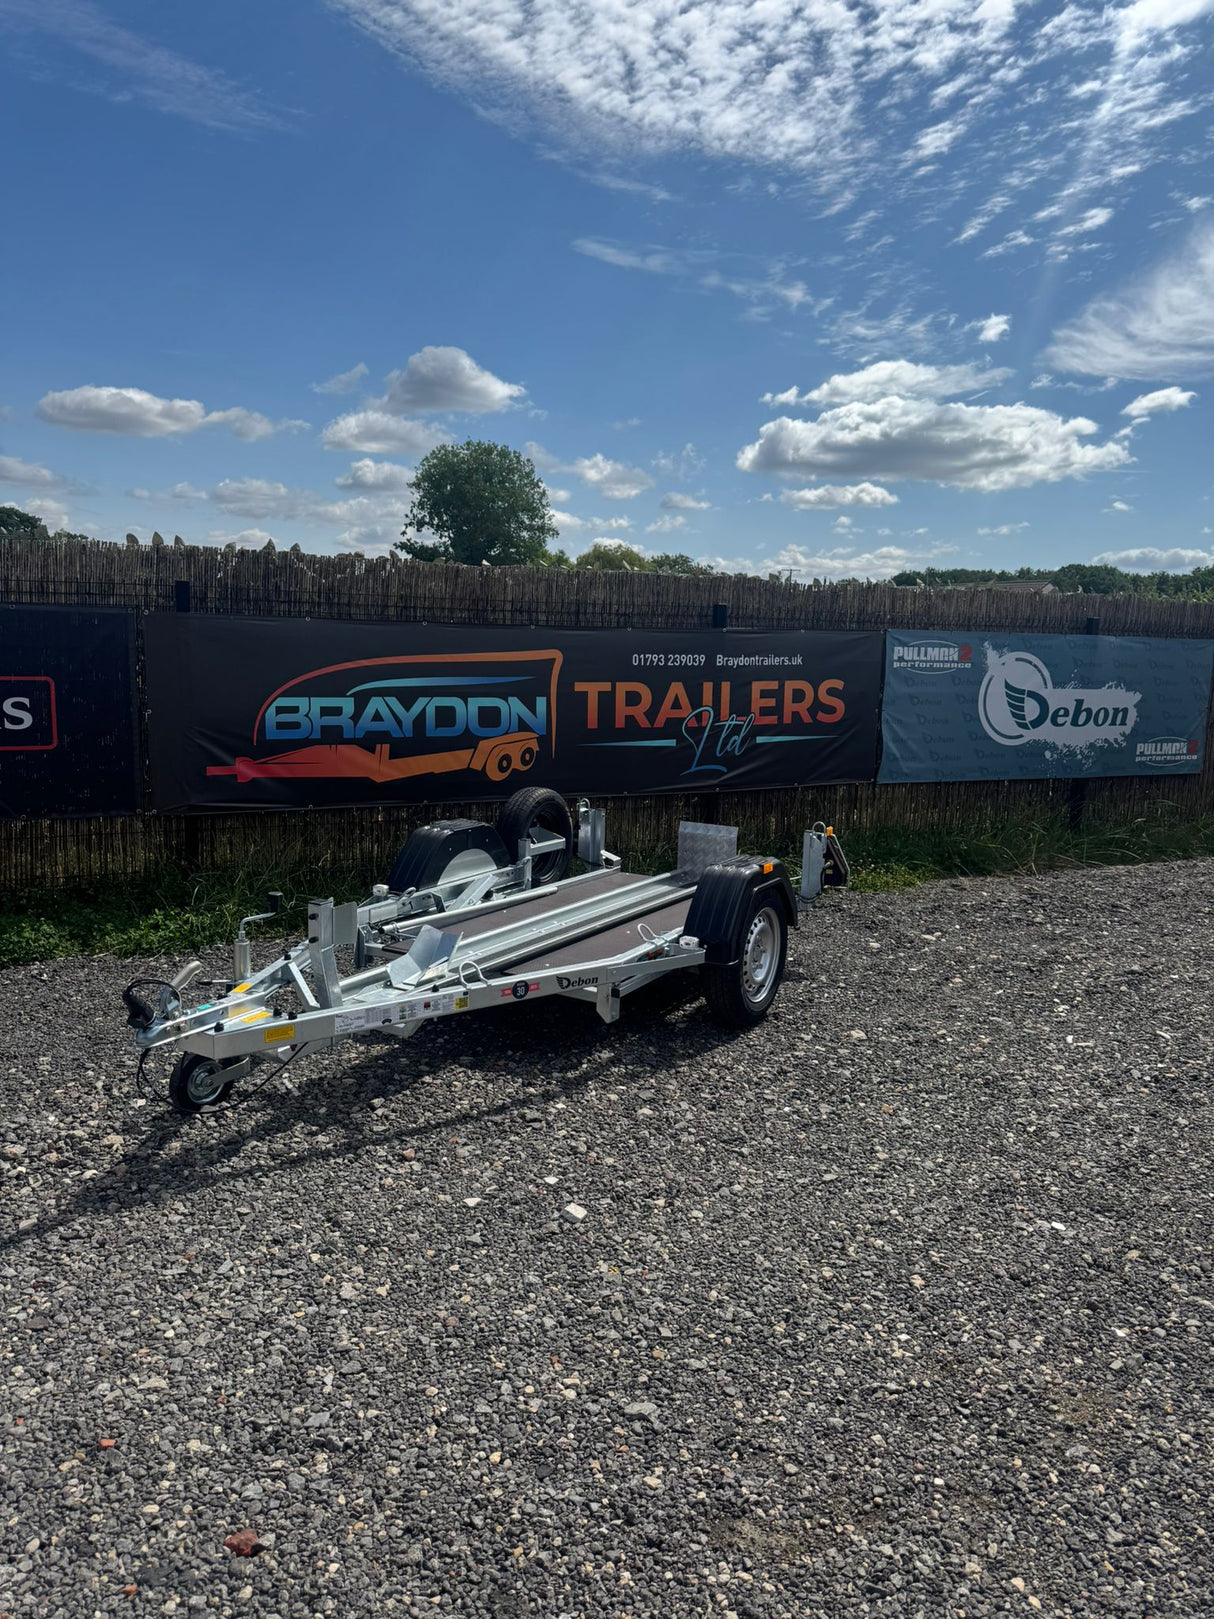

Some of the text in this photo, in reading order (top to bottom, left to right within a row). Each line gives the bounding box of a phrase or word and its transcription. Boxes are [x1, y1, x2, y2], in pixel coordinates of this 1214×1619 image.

[632, 654, 803, 668] 01793 239039 Braydontrailers.uk
[0, 697, 33, 730] S
[265, 696, 547, 740] BRAYDON
[574, 678, 846, 729] TRAILERS
[1004, 678, 1130, 731] Debon
[680, 706, 755, 776] Ltd
[555, 976, 599, 990] Debon
